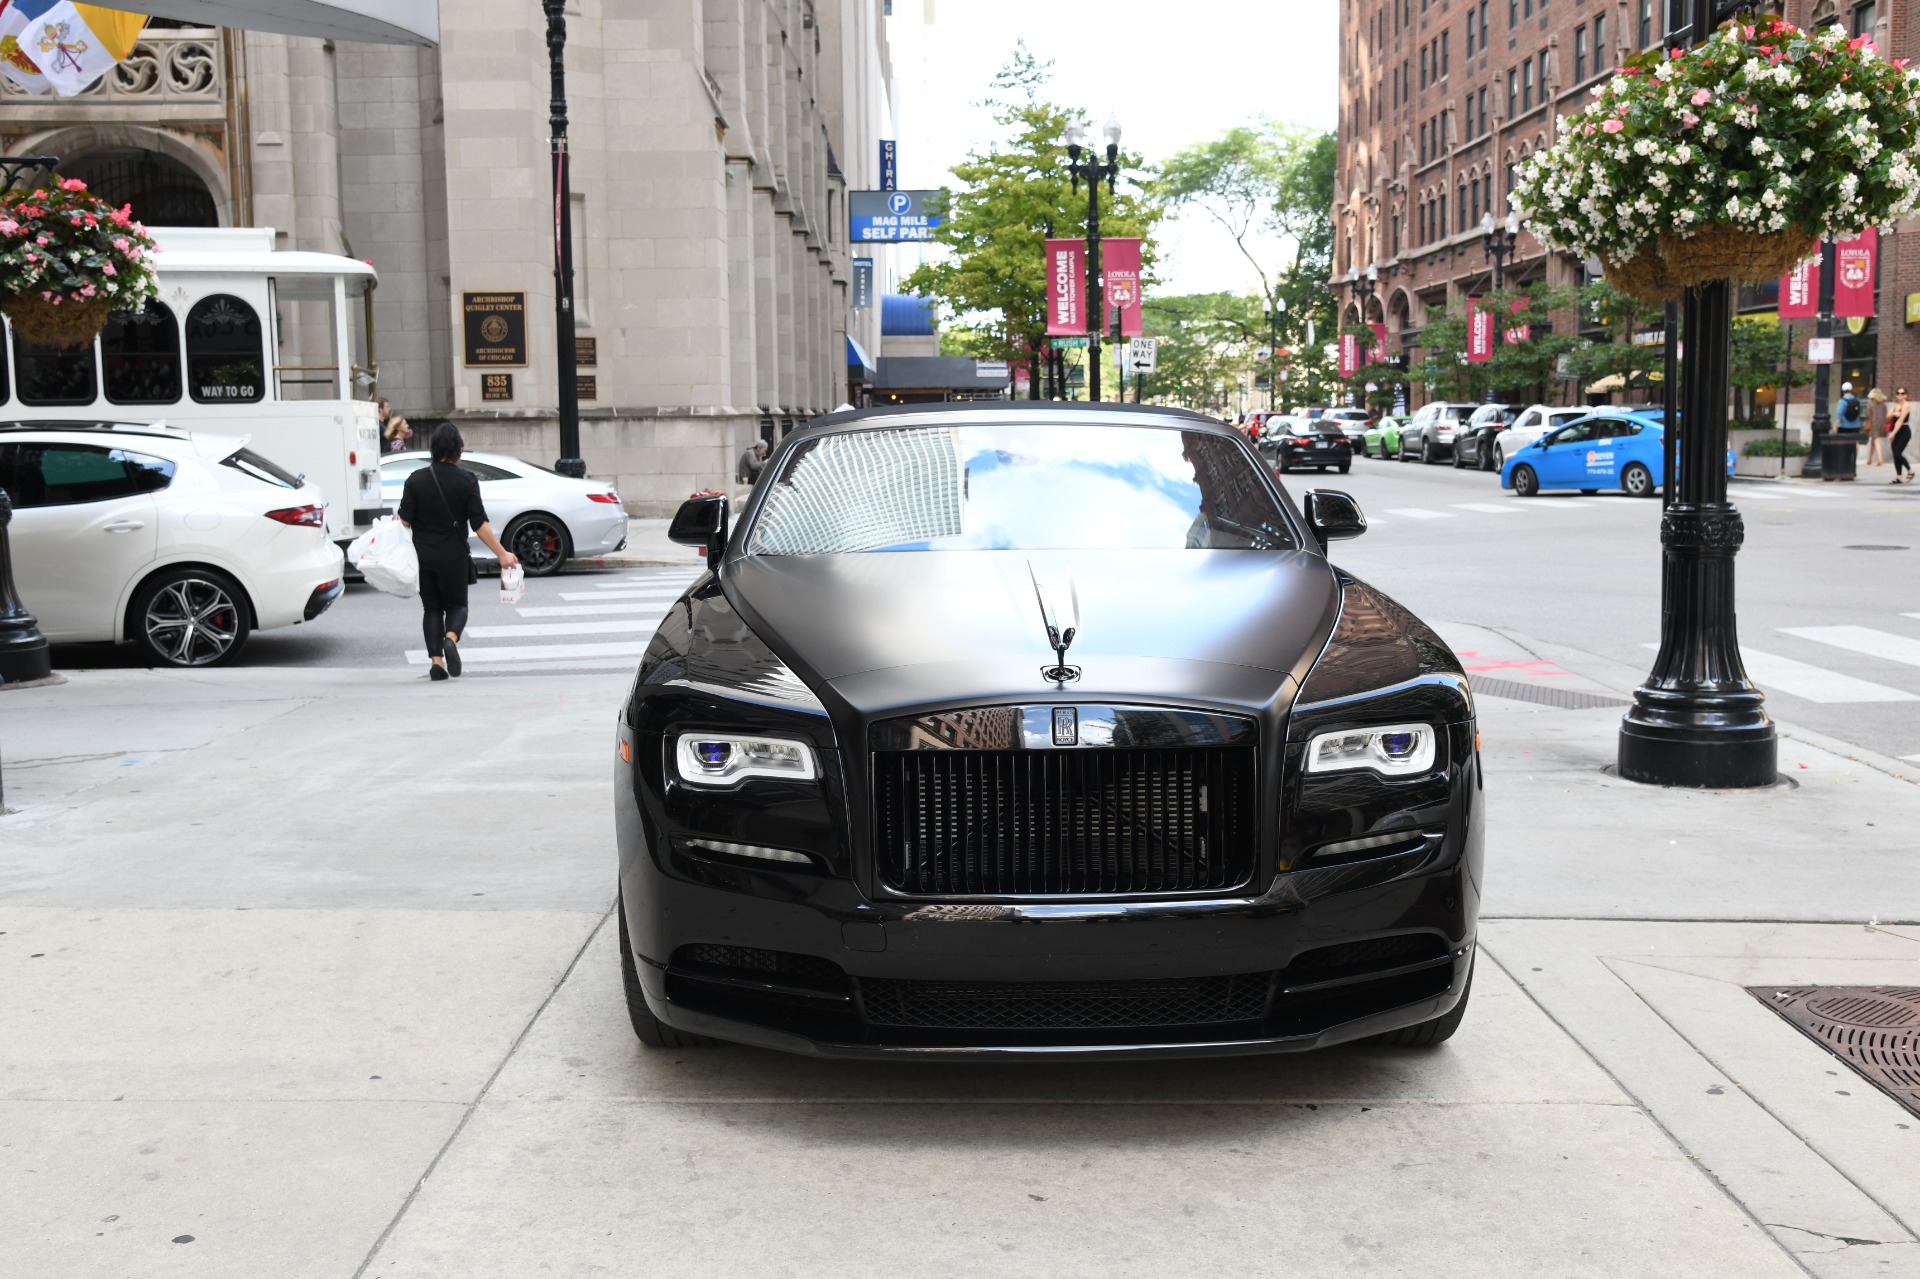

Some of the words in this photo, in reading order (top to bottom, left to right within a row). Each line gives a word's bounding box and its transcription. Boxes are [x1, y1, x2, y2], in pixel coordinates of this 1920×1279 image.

[872, 216, 898, 226] MAG
[900, 216, 928, 225] MILE
[862, 227, 897, 239] SELF
[1840, 248, 1870, 257] LOYOLA
[1056, 250, 1069, 325] WELCOME
[1058, 339, 1078, 348] RUSH
[1134, 340, 1153, 349] ONE
[1133, 350, 1153, 359] WAY
[487, 375, 507, 387] 835
[201, 386, 223, 397] WAY
[226, 386, 237, 397] TO
[241, 385, 255, 397] GO
